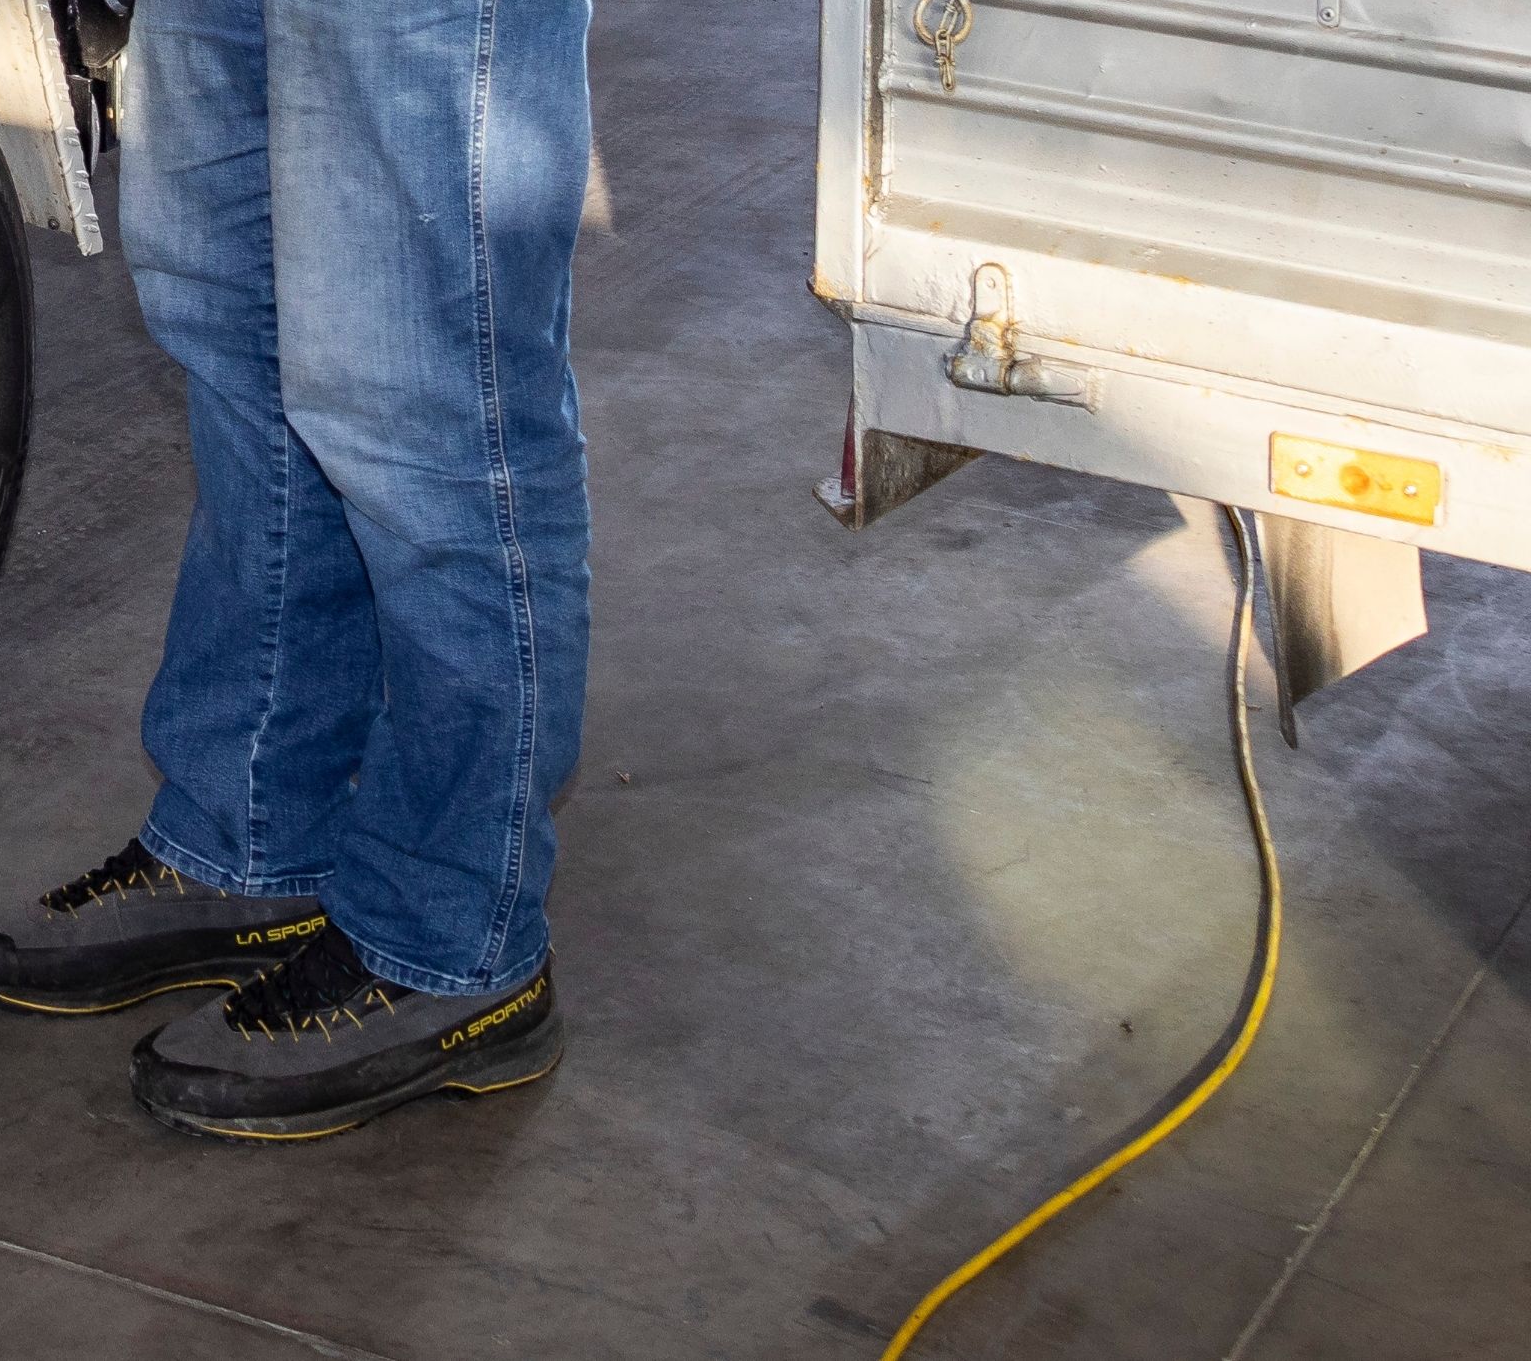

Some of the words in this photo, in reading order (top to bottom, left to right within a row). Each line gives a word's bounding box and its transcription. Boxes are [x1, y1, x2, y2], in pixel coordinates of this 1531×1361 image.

[236, 931, 263, 946] LA
[267, 915, 329, 943] SPOR
[442, 1031, 464, 1050] LA
[467, 976, 548, 1039] SPORTIVA
